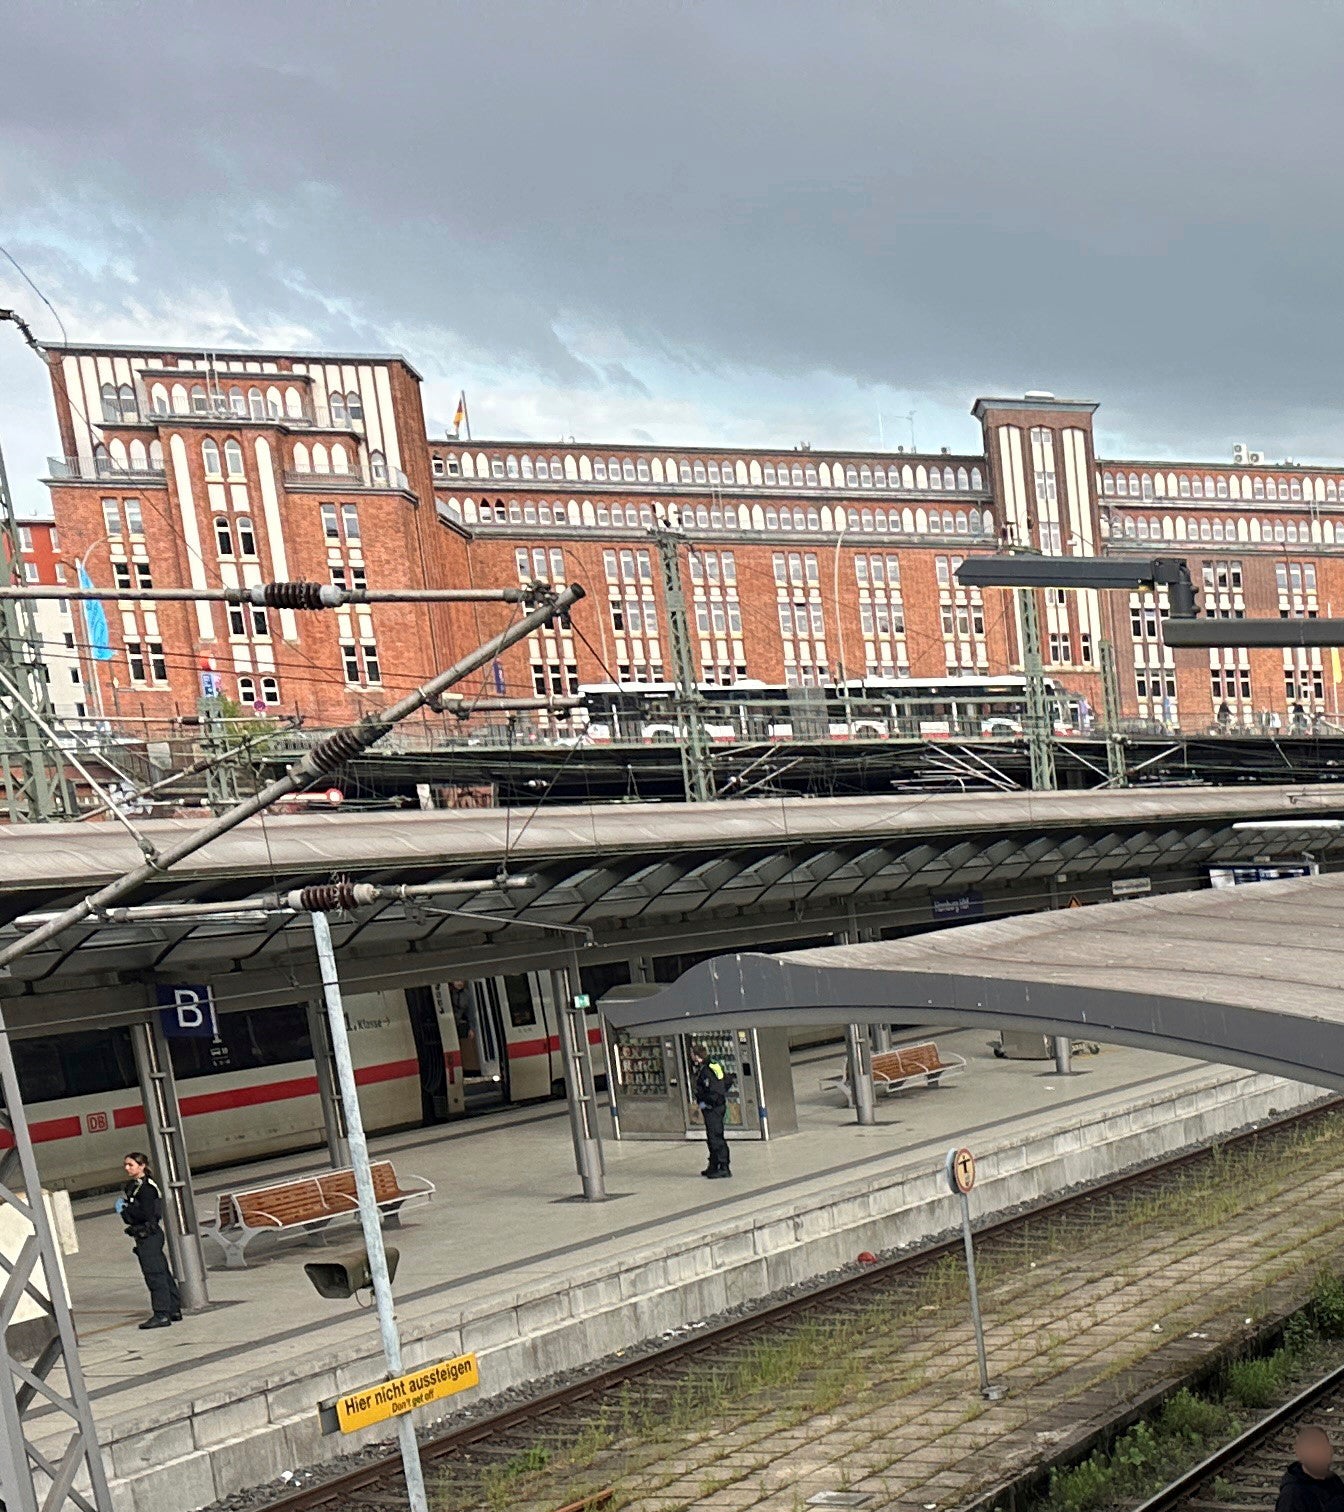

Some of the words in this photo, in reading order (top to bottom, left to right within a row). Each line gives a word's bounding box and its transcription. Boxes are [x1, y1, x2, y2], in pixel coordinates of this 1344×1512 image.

[173, 989, 204, 1028] B
[88, 1114, 106, 1131] DB
[344, 1396, 372, 1416] Hier
[374, 1382, 406, 1406] nicht
[408, 1359, 472, 1393] aussteigen
[391, 1399, 412, 1414] Don't
